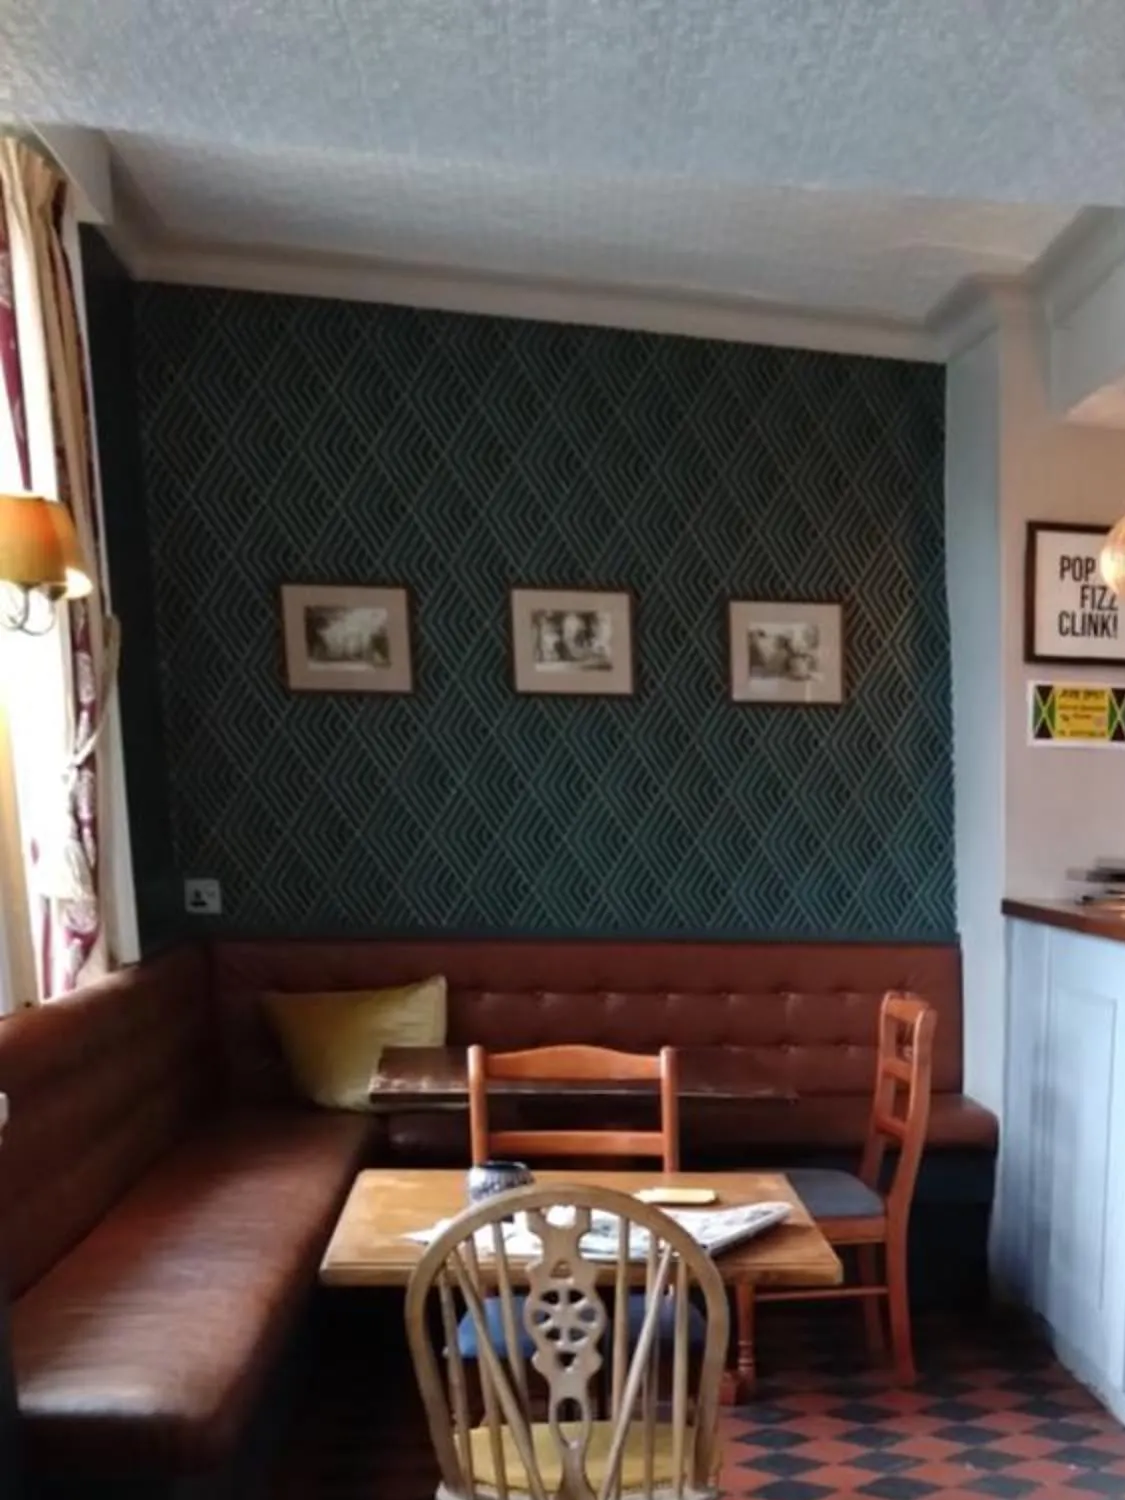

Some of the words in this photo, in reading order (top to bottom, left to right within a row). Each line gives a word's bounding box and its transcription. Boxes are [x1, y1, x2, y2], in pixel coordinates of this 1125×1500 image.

[1059, 555, 1096, 582] POP
[1080, 584, 1118, 611] FIZZ
[1058, 610, 1118, 640] CLINK!
